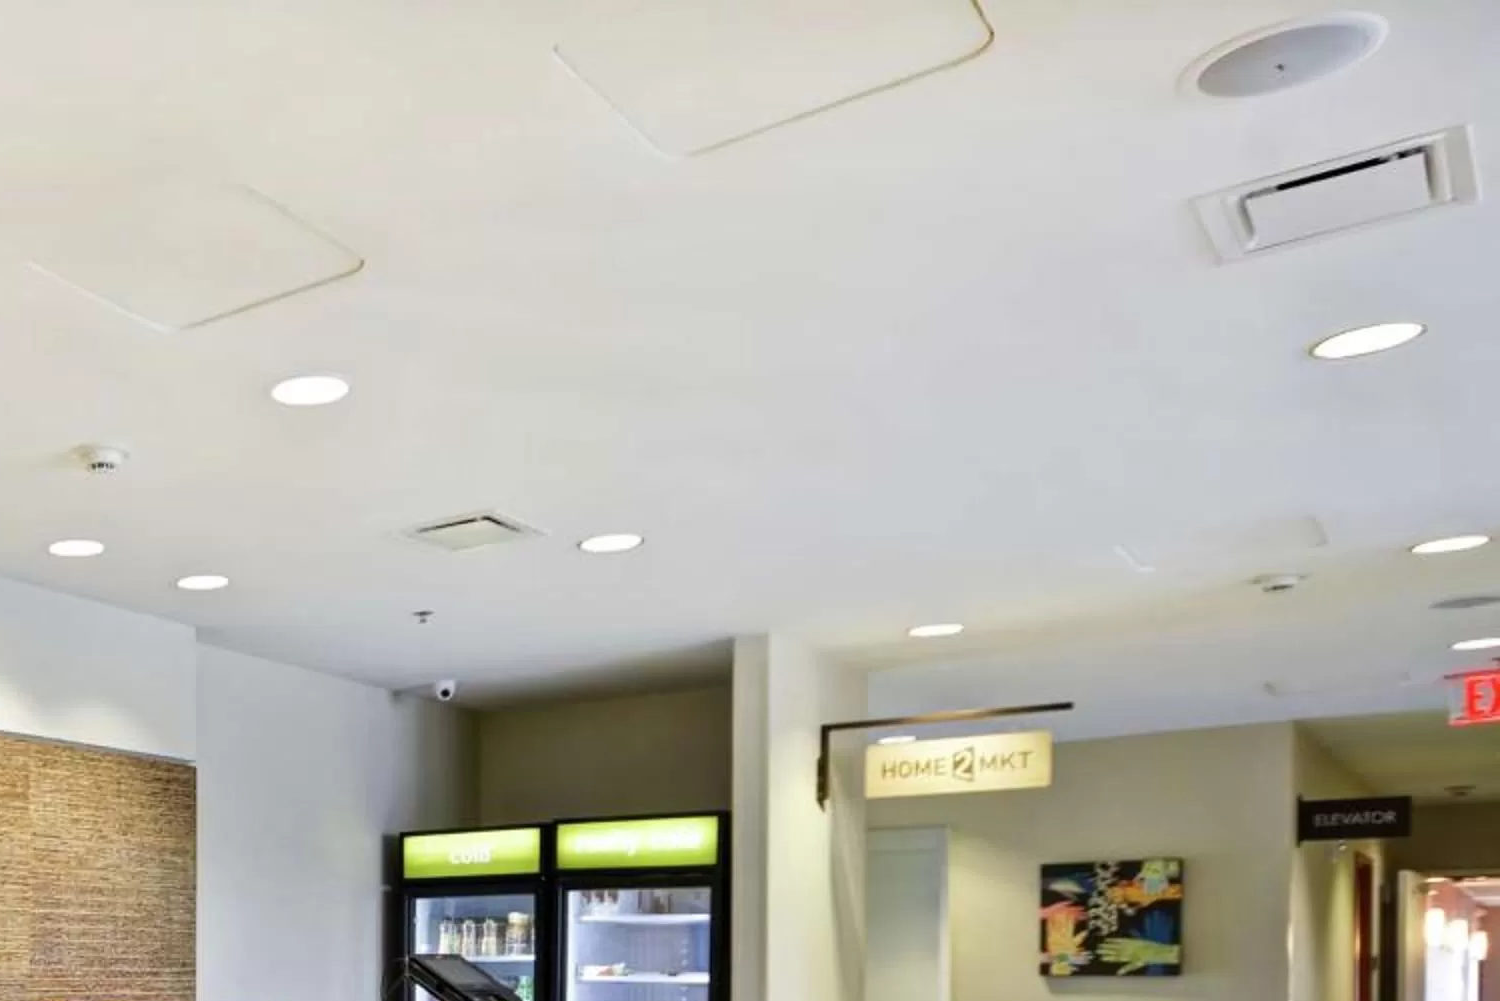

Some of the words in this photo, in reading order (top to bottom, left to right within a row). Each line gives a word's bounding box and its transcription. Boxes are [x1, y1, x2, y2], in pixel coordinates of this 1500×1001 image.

[881, 756, 946, 780] HOME
[979, 750, 1035, 772] MKT
[1313, 810, 1397, 827] ELEVATOR
